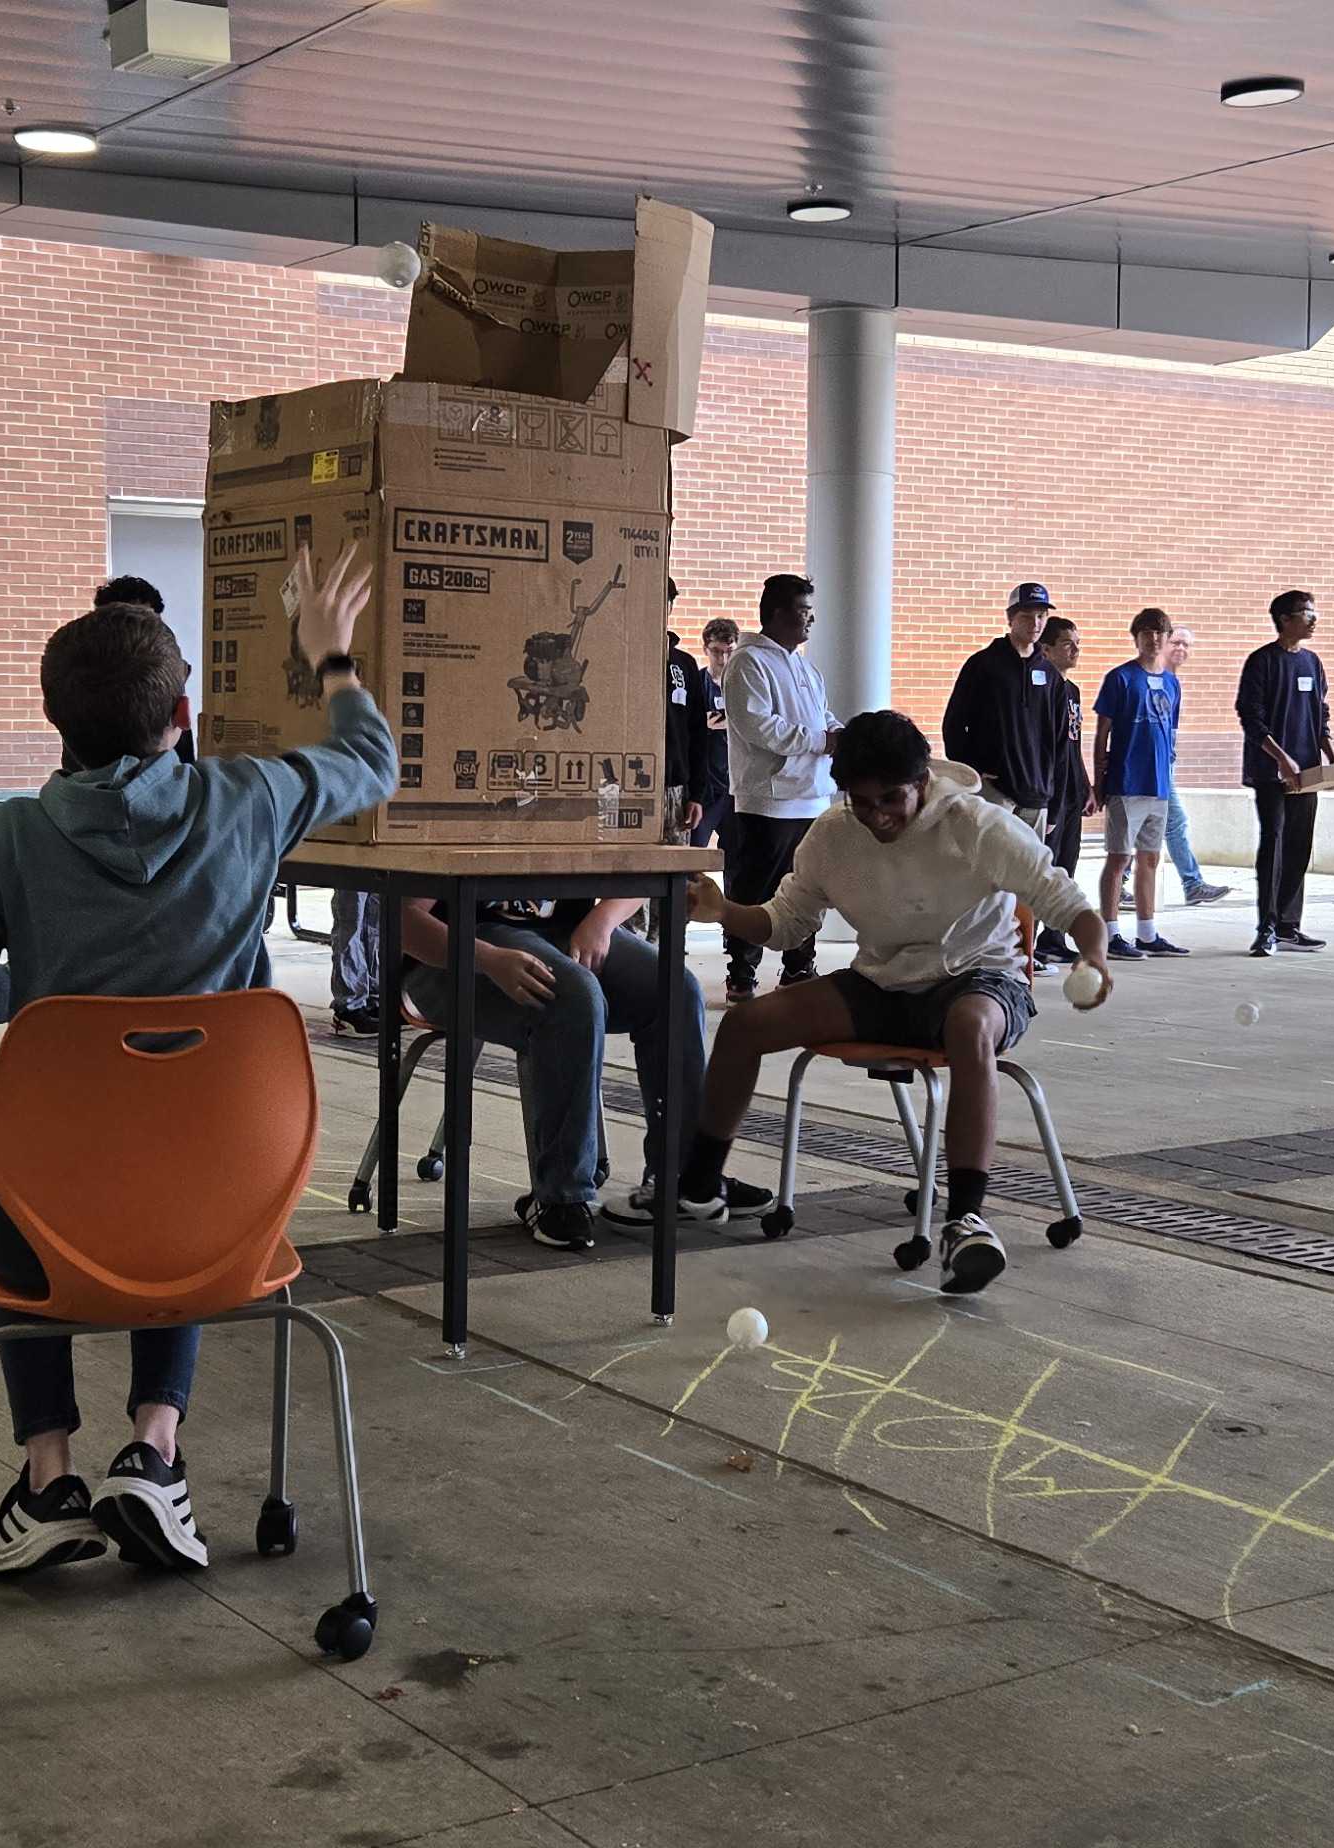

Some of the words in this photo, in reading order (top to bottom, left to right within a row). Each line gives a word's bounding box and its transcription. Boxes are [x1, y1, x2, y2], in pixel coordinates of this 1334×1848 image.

[213, 529, 283, 557] CRAFTSMAN
[404, 518, 540, 551] CRAFTSMAN
[408, 568, 441, 586] GAS
[455, 762, 477, 776] USA
